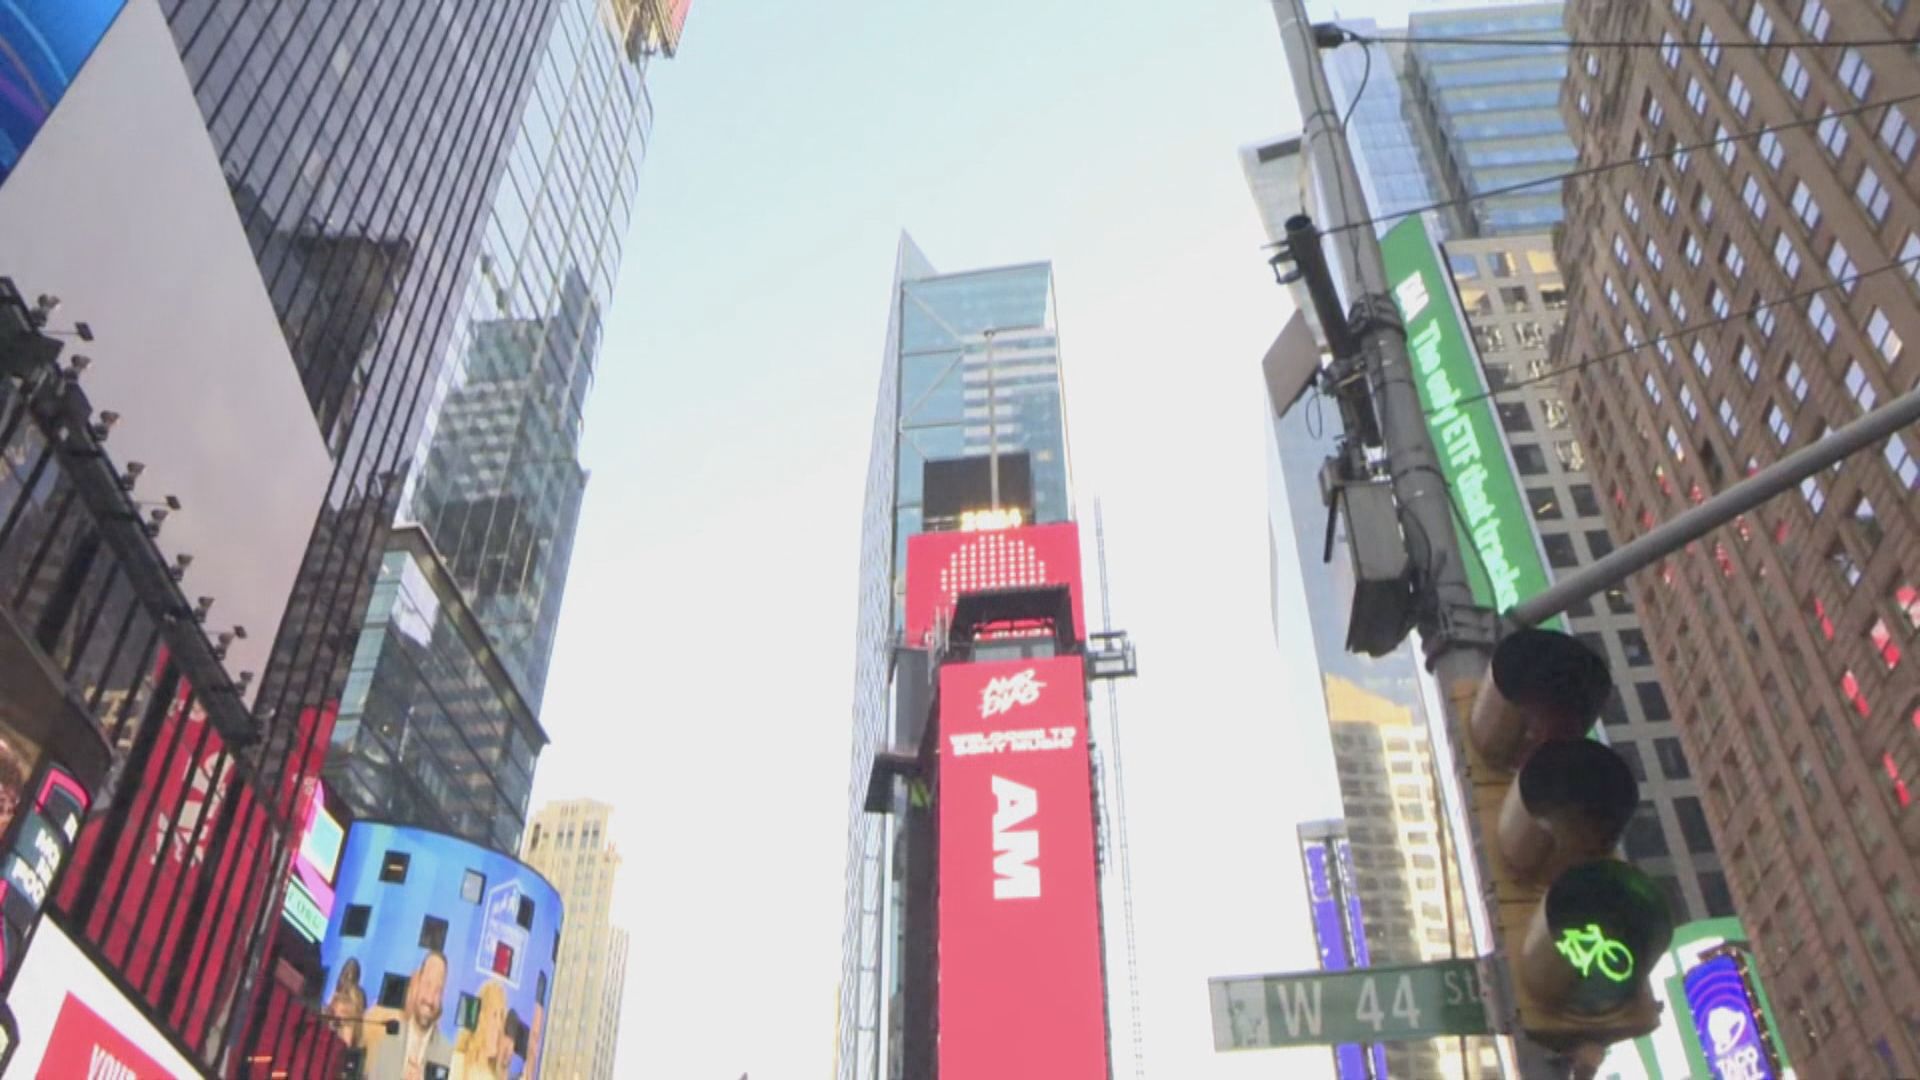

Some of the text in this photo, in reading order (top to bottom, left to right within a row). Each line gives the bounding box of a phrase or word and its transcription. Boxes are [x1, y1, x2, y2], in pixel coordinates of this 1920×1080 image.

[1412, 317, 1441, 375] The
[1426, 367, 1461, 426] only
[1442, 413, 1480, 467] ETF
[1457, 463, 1495, 527] that
[1474, 518, 1520, 615] tracks
[991, 774, 1041, 900] AM
[1277, 980, 1322, 1037] W
[1356, 975, 1421, 1031] 44
